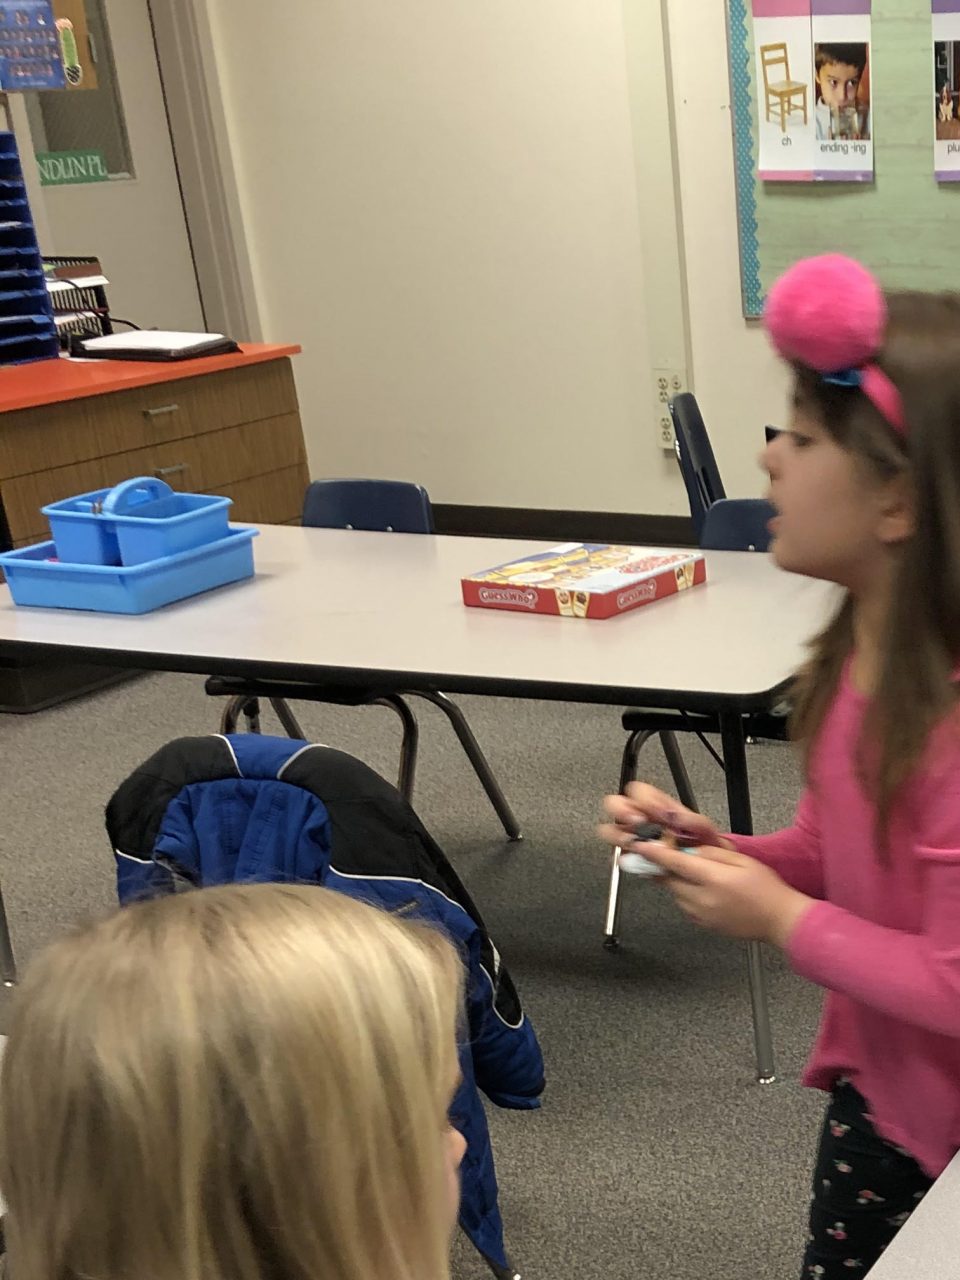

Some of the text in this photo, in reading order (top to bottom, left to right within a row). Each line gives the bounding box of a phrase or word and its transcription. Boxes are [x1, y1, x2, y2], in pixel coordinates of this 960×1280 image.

[781, 135, 793, 147] ch
[820, 142, 867, 155] ending -ing
